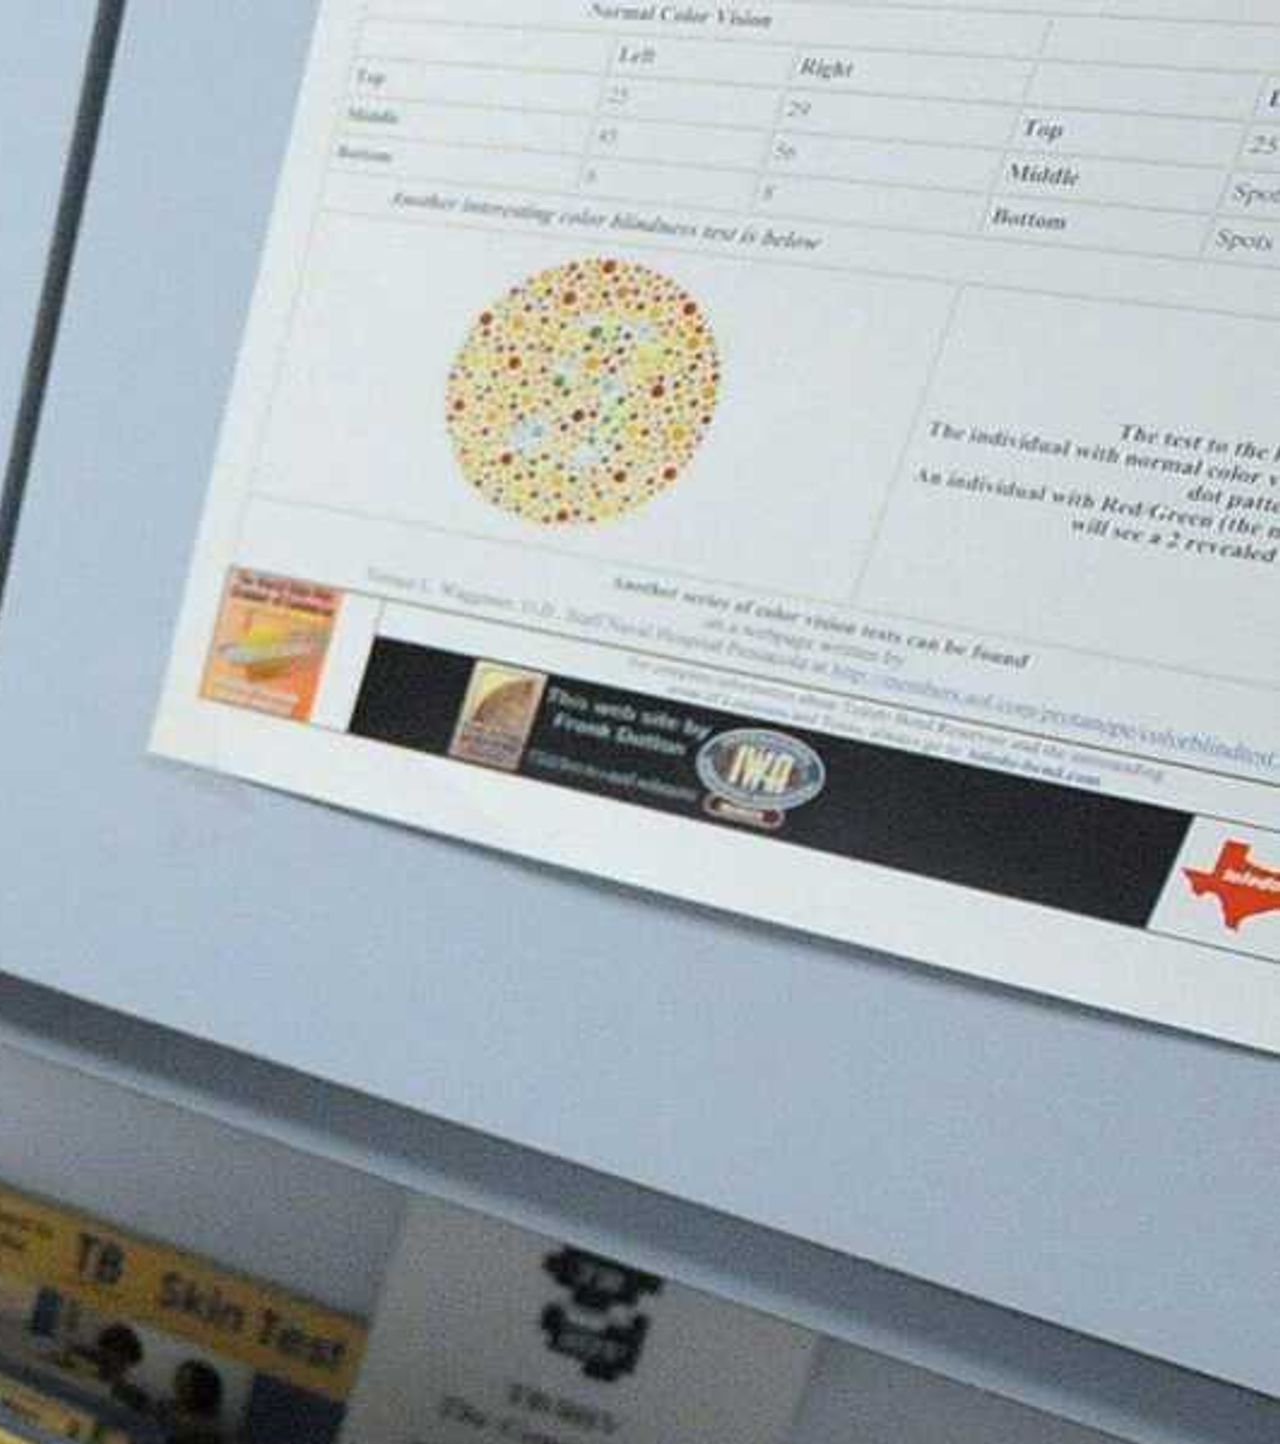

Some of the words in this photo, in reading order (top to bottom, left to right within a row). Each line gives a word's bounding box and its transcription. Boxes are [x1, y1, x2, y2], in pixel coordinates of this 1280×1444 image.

[587, 0, 656, 22] Normal
[659, 5, 711, 25] Color
[717, 9, 774, 29] Vision
[355, 66, 385, 89] Top
[617, 46, 657, 65] Left
[800, 57, 855, 81] Right
[1024, 117, 1067, 142] Top
[1007, 162, 1081, 188] Middle
[392, 190, 457, 214] Another
[461, 195, 555, 227] interesting
[558, 207, 607, 229] color
[610, 211, 697, 239] blindness
[702, 224, 738, 244] test
[740, 228, 758, 245] is
[760, 228, 824, 252] below
[990, 206, 1068, 233] Bottom
[1215, 228, 1274, 252] Spots
[929, 420, 966, 443] The
[967, 424, 1071, 459] individual
[1075, 442, 1121, 467] with
[1125, 451, 1203, 479] normal
[1206, 463, 1263, 487] color
[1120, 423, 1159, 445] The
[1164, 430, 1202, 452] test
[1208, 435, 1230, 454] to
[1234, 438, 1269, 462] the
[914, 468, 942, 487] An
[945, 473, 1046, 503] individual
[1052, 489, 1096, 511] with
[1217, 512, 1262, 538] (the
[1187, 485, 1222, 505] dot
[1071, 518, 1109, 538] will
[1112, 527, 1141, 545] see
[1148, 532, 1163, 546] a
[1167, 531, 1181, 551] 2
[1183, 536, 1278, 565] revealed
[612, 573, 679, 600] Another
[681, 586, 734, 613] series
[737, 596, 755, 615] of
[755, 601, 804, 624] color
[806, 615, 857, 639] vision
[861, 624, 903, 646] tests
[906, 633, 941, 655] can
[944, 637, 966, 657] be
[970, 641, 1031, 671] found
[883, 650, 906, 669] by
[548, 685, 589, 714] This
[593, 699, 637, 723] web
[641, 708, 679, 732] site
[682, 718, 715, 741] by
[552, 711, 611, 740] Frank
[78, 1229, 125, 1285] TB
[162, 1270, 244, 1335] Skin
[257, 1306, 346, 1366] Test
